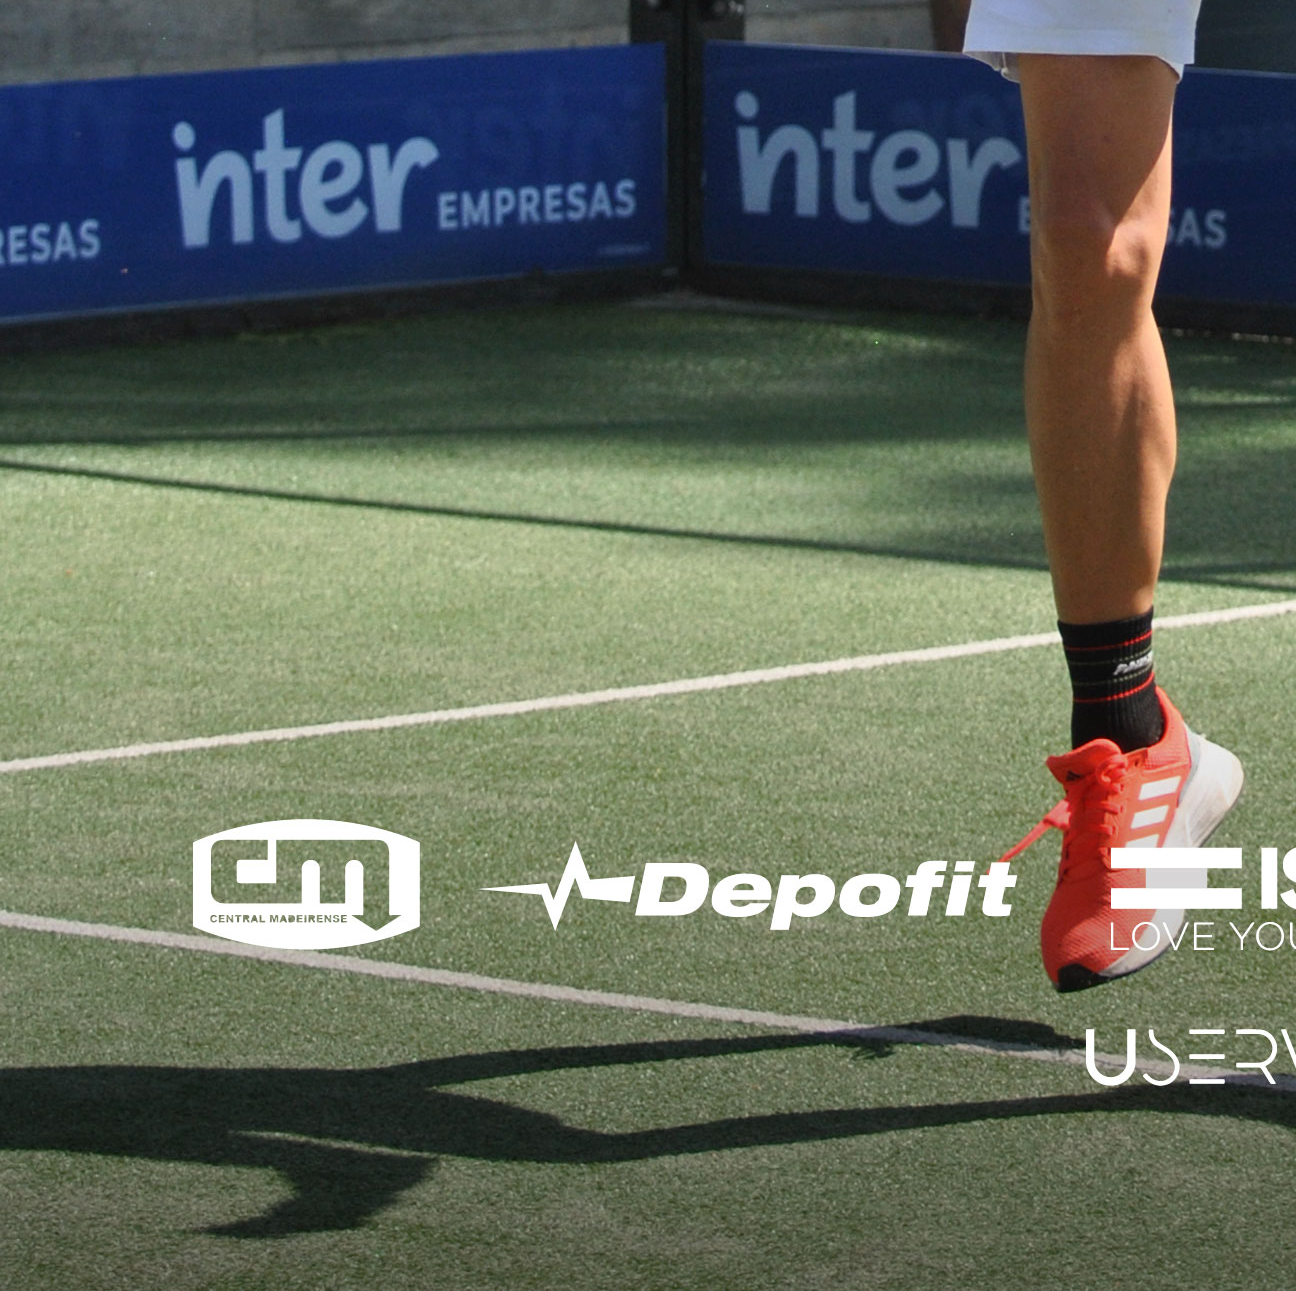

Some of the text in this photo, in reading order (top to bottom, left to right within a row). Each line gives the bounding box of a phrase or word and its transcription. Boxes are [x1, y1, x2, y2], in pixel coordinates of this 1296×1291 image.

[172, 108, 636, 247] inter EMPRESAS
[736, 91, 1019, 227] inter
